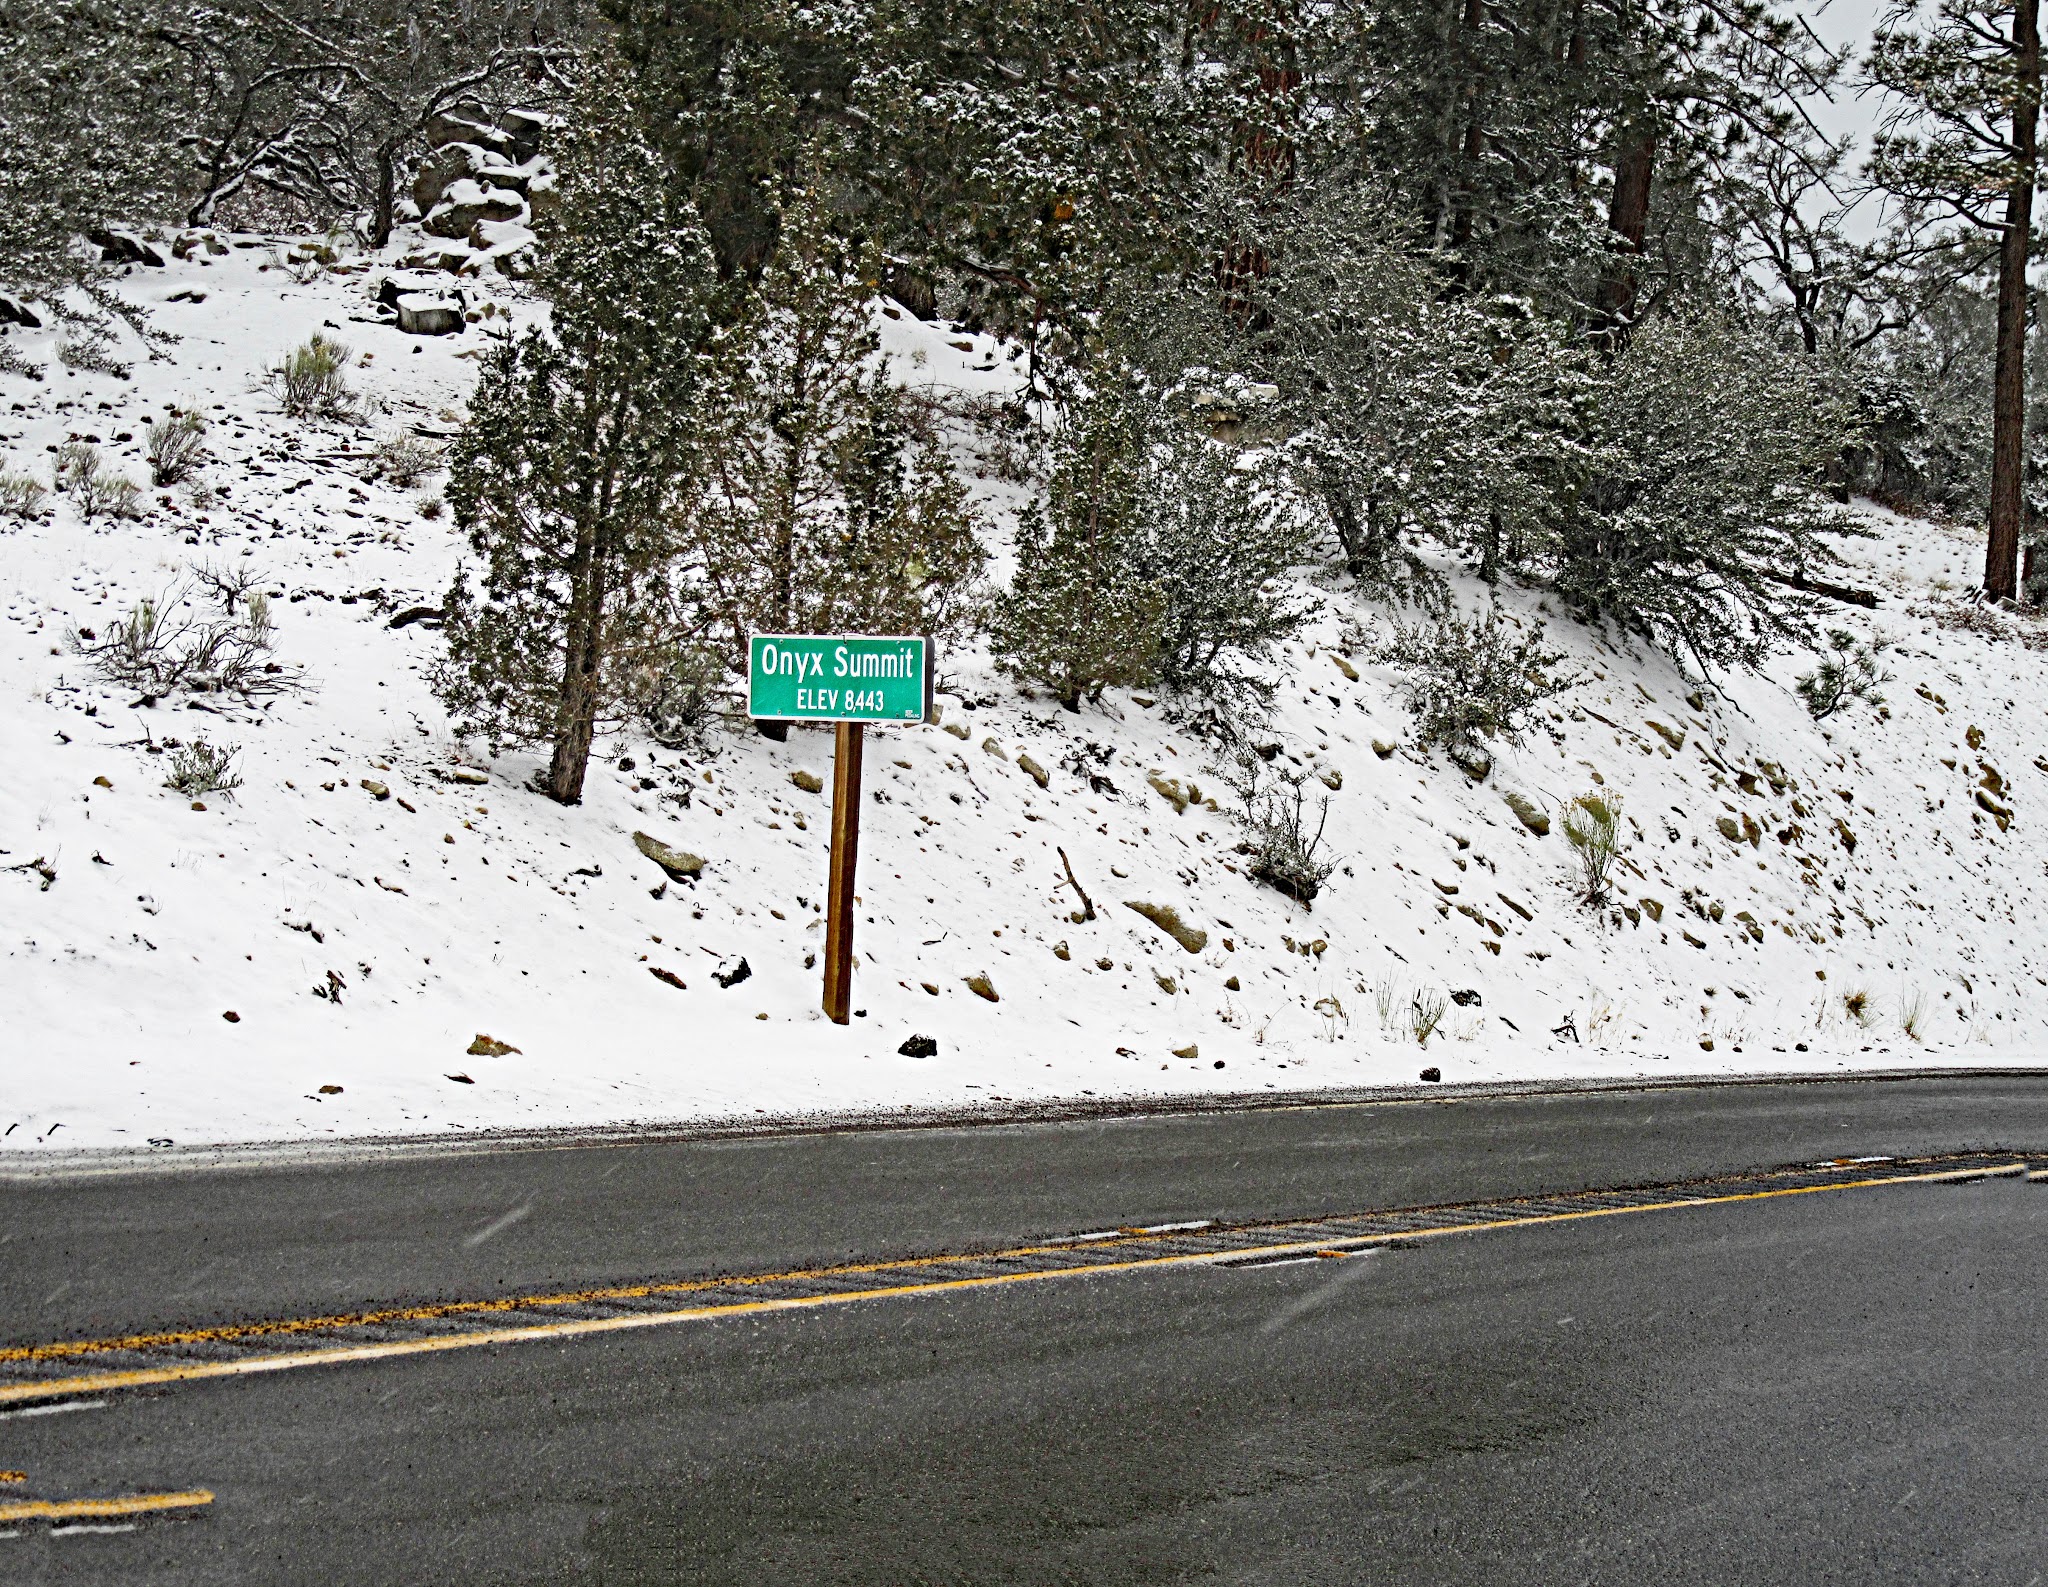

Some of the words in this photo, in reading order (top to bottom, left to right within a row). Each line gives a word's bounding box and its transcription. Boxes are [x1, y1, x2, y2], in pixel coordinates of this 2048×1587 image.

[761, 643, 823, 683] Onyx
[833, 645, 914, 677] Summit
[797, 688, 839, 710] ELEV
[844, 689, 884, 713] 8,443
